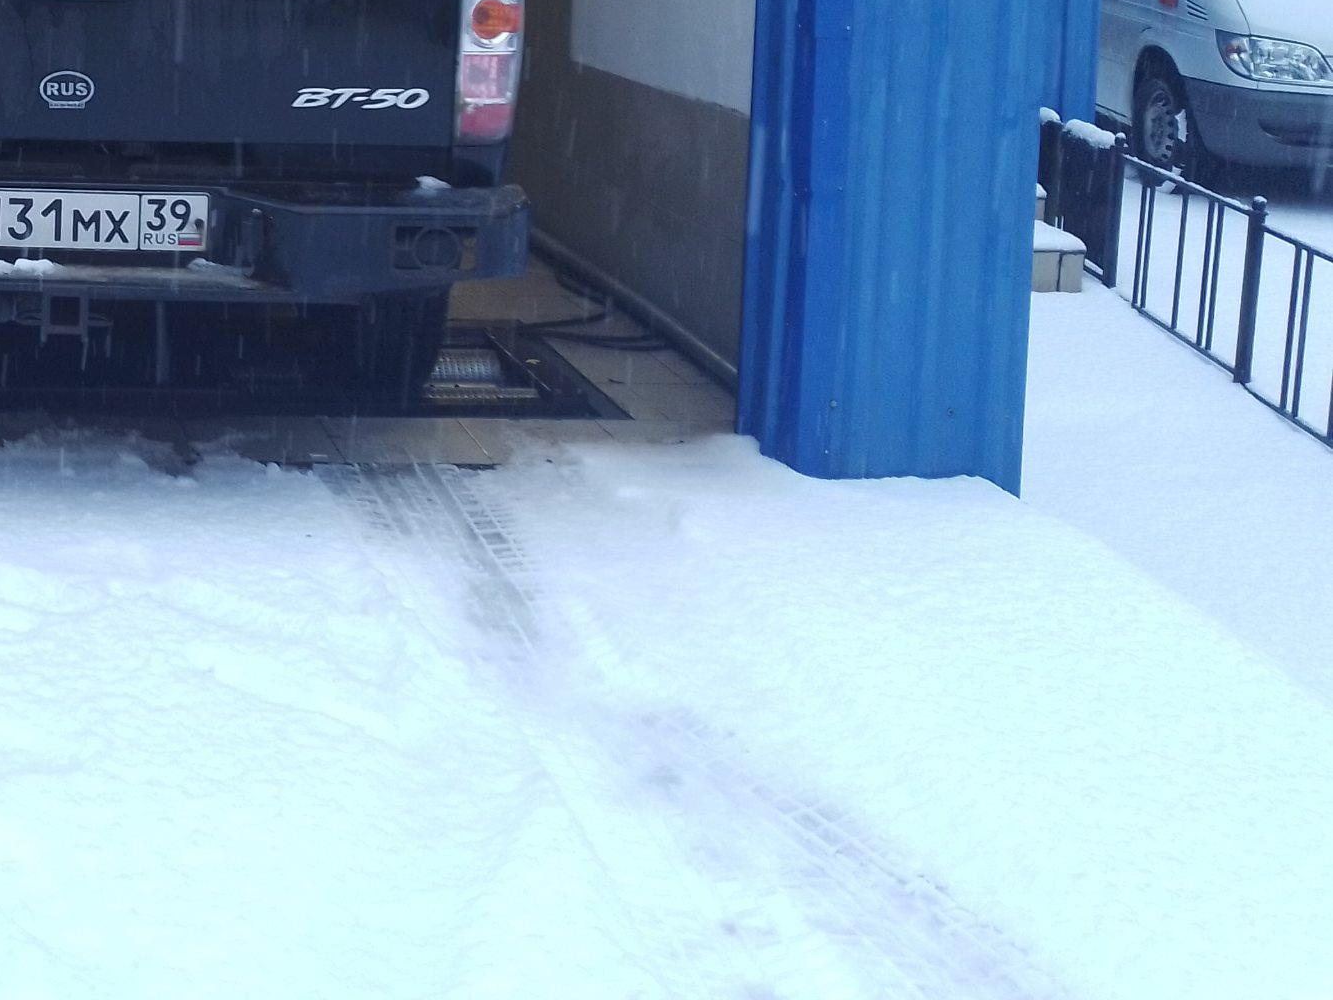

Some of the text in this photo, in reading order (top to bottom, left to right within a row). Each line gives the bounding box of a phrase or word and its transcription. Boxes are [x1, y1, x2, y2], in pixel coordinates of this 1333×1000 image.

[45, 80, 89, 97] RUS
[290, 87, 430, 110] BT-50
[145, 198, 192, 233] 39
[142, 232, 177, 246] RUS
